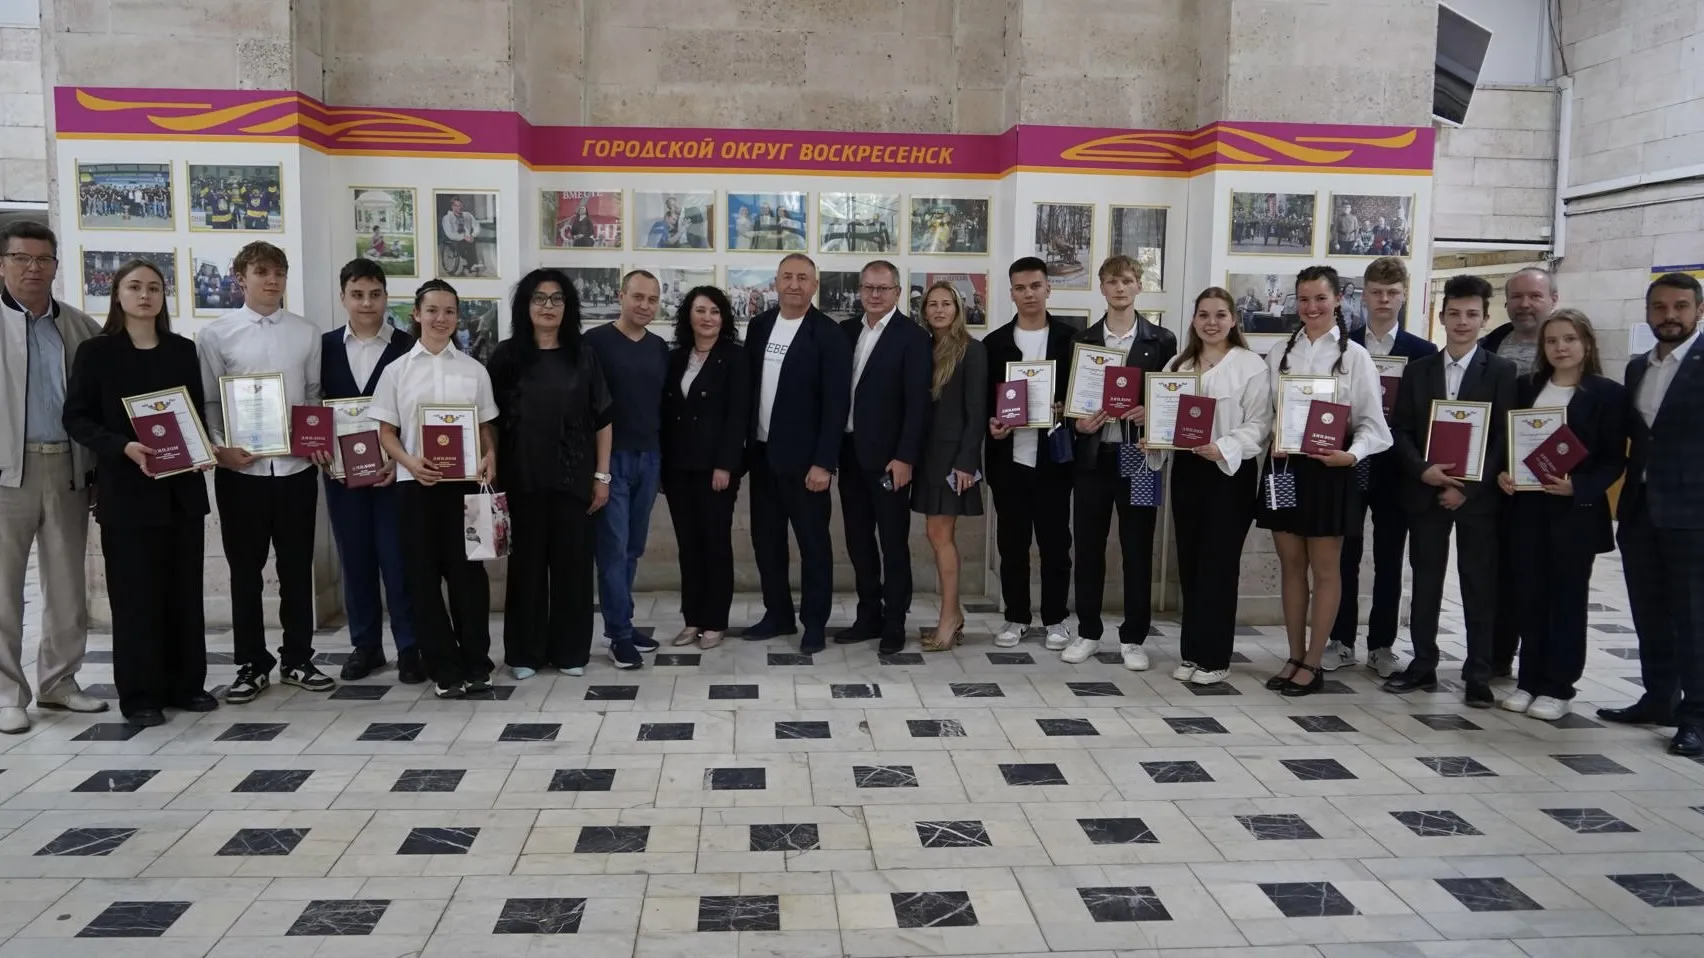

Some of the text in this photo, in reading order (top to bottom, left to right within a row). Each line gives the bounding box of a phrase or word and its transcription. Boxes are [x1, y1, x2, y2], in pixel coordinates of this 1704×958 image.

[582, 138, 954, 164] ГОРОДСКОЙ ОКРУГ ВОСКРЕСЕНСК
